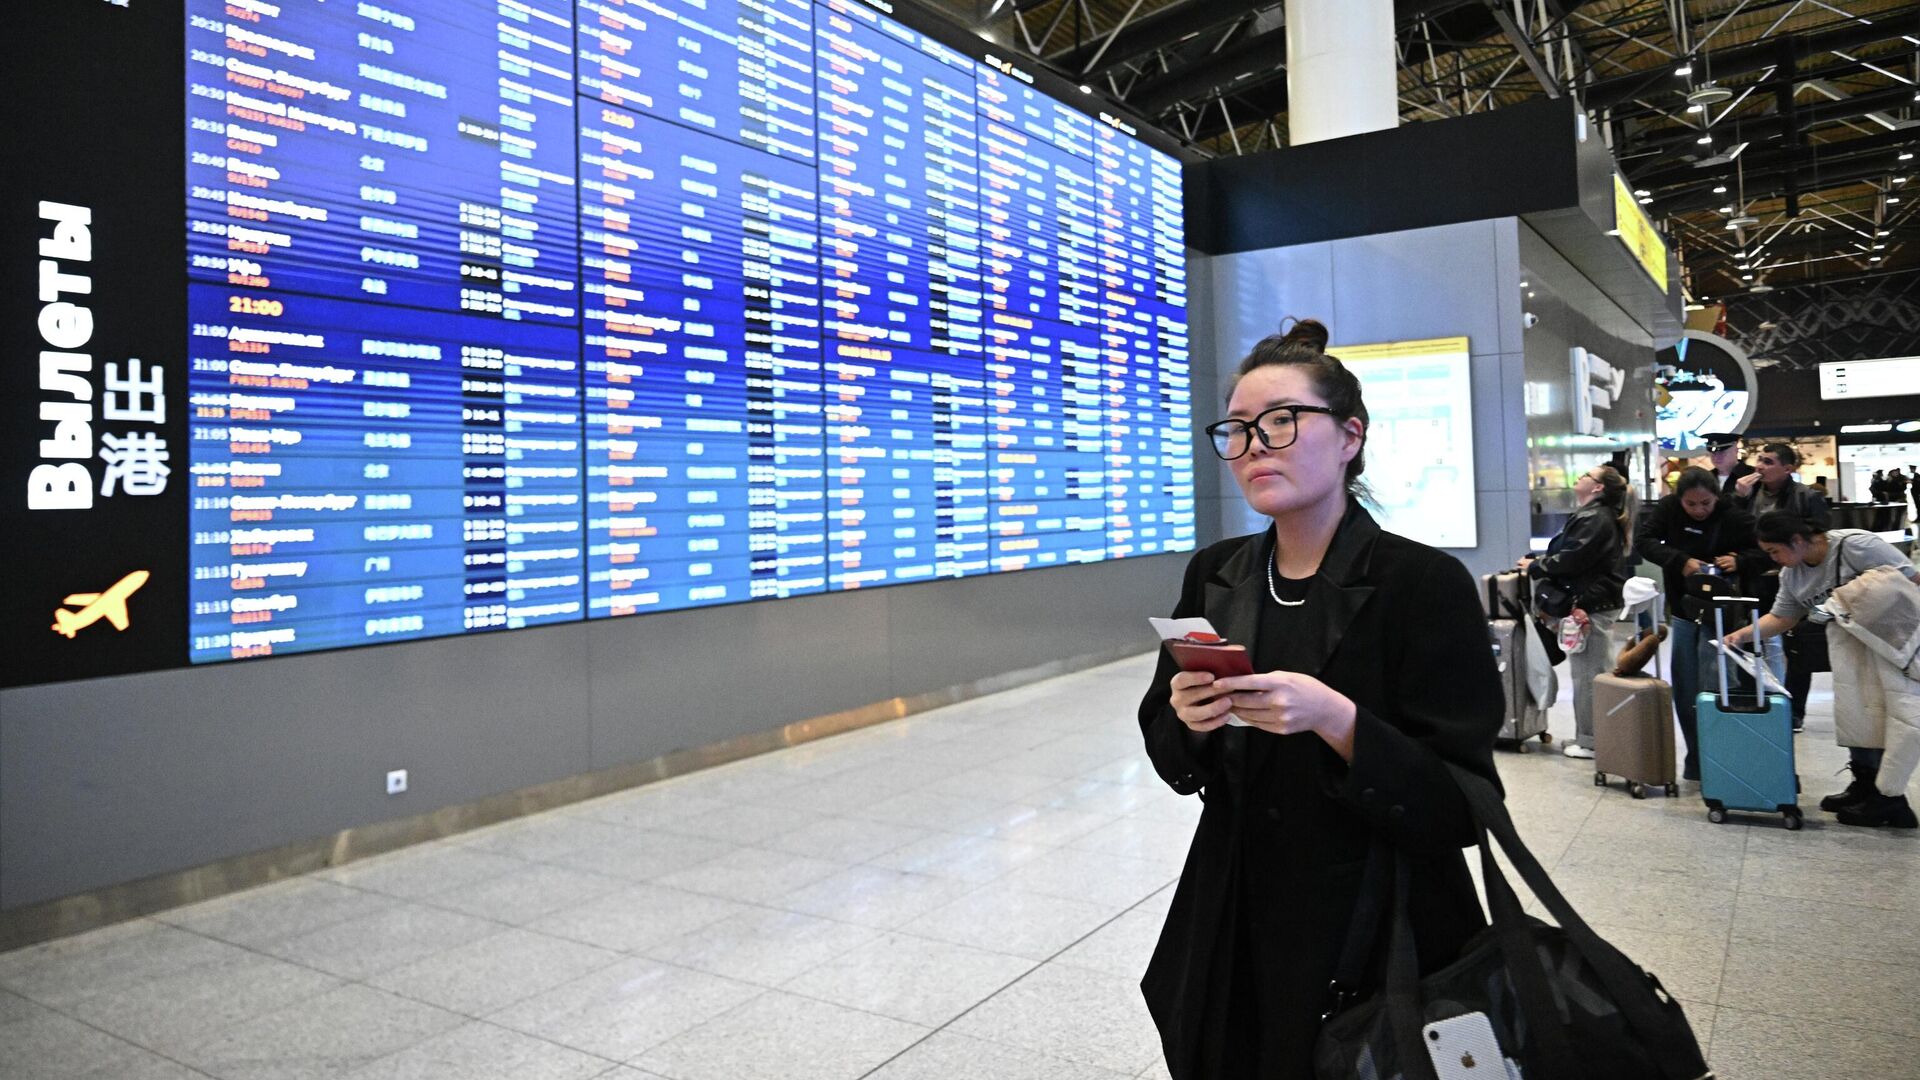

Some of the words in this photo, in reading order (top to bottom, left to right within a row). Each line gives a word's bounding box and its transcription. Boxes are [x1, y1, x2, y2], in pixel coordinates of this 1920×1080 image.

[193, 323, 228, 338] 21:00
[230, 297, 283, 316] 21:00
[28, 200, 93, 510] Вылеты
[99, 358, 171, 497] 出港
